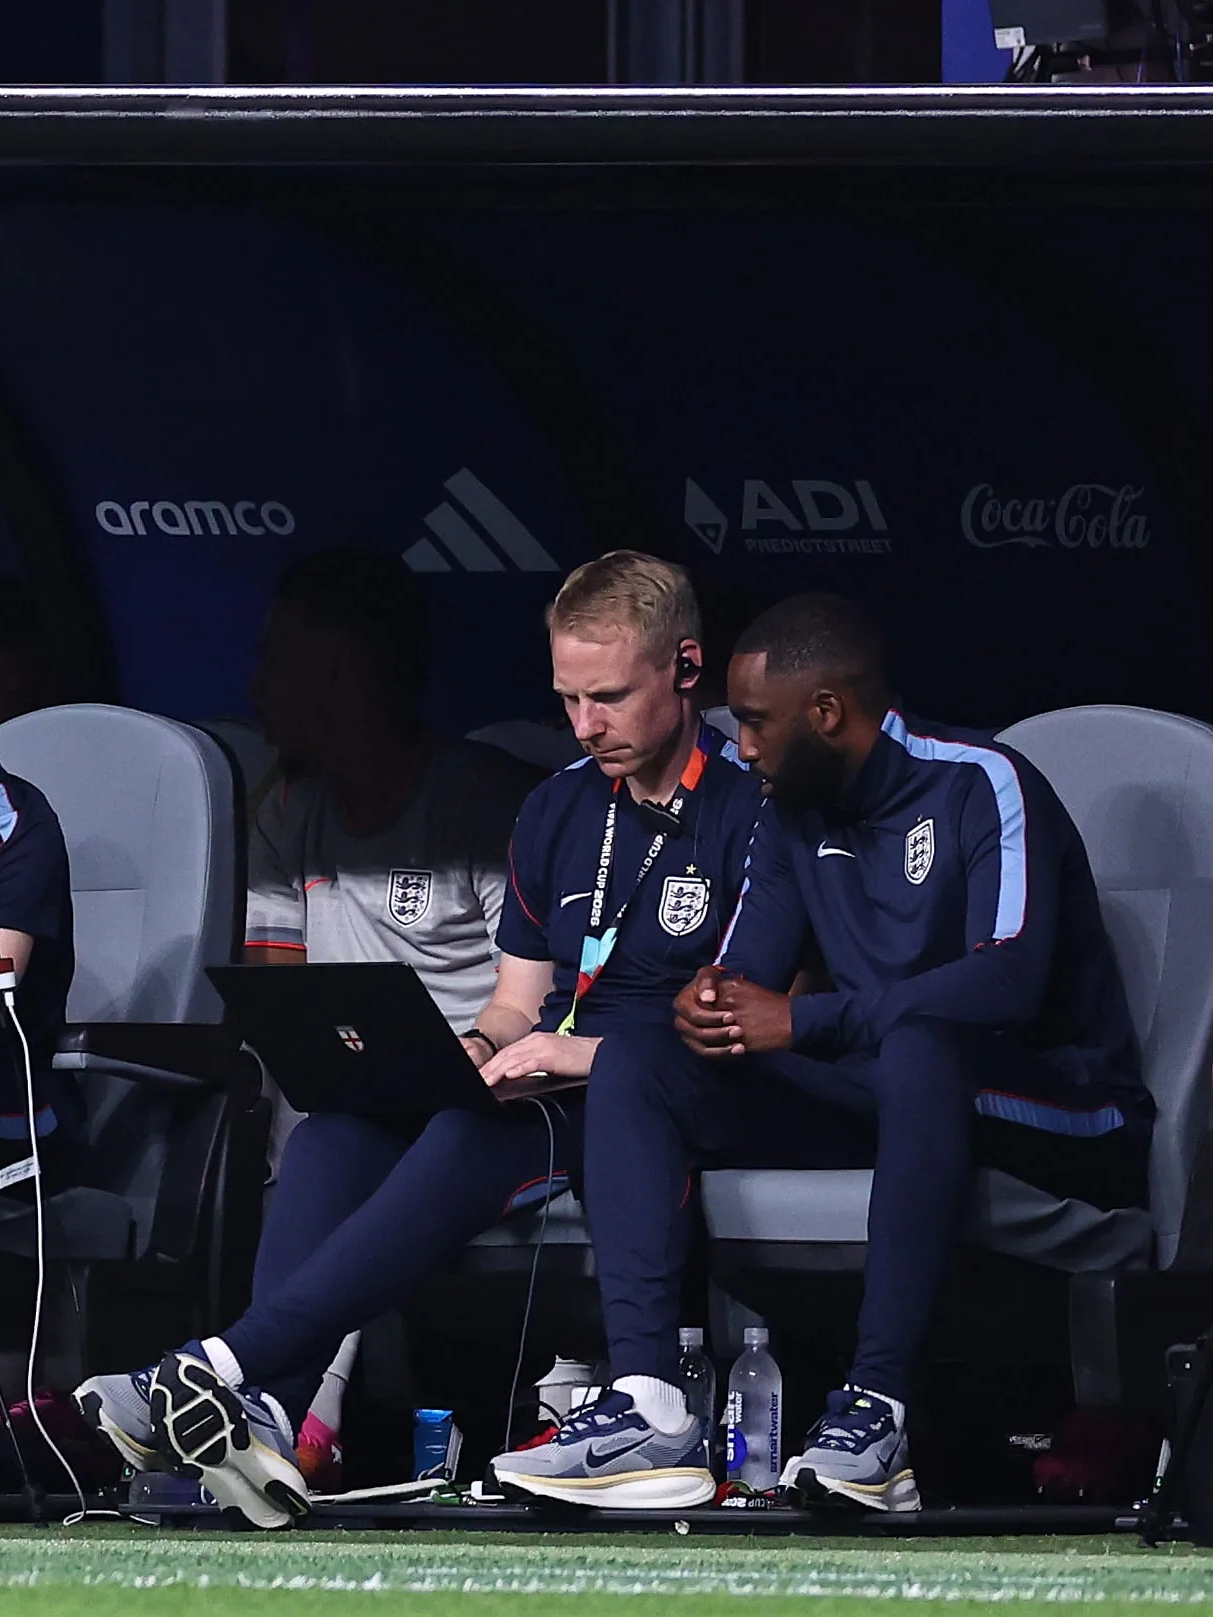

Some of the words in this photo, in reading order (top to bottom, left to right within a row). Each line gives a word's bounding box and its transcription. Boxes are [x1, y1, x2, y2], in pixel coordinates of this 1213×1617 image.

[95, 500, 295, 536] aramco
[740, 479, 888, 531] ADI
[960, 483, 1152, 549] Coca-Cola
[744, 537, 893, 554] PREDICTSTREET
[600, 826, 615, 867] WORLD
[648, 834, 664, 858] CUP
[596, 867, 608, 889] CUP
[590, 889, 604, 927] 2026
[735, 1391, 743, 1423] water
[726, 1391, 736, 1462] smart
[769, 1391, 779, 1473] smartwater
